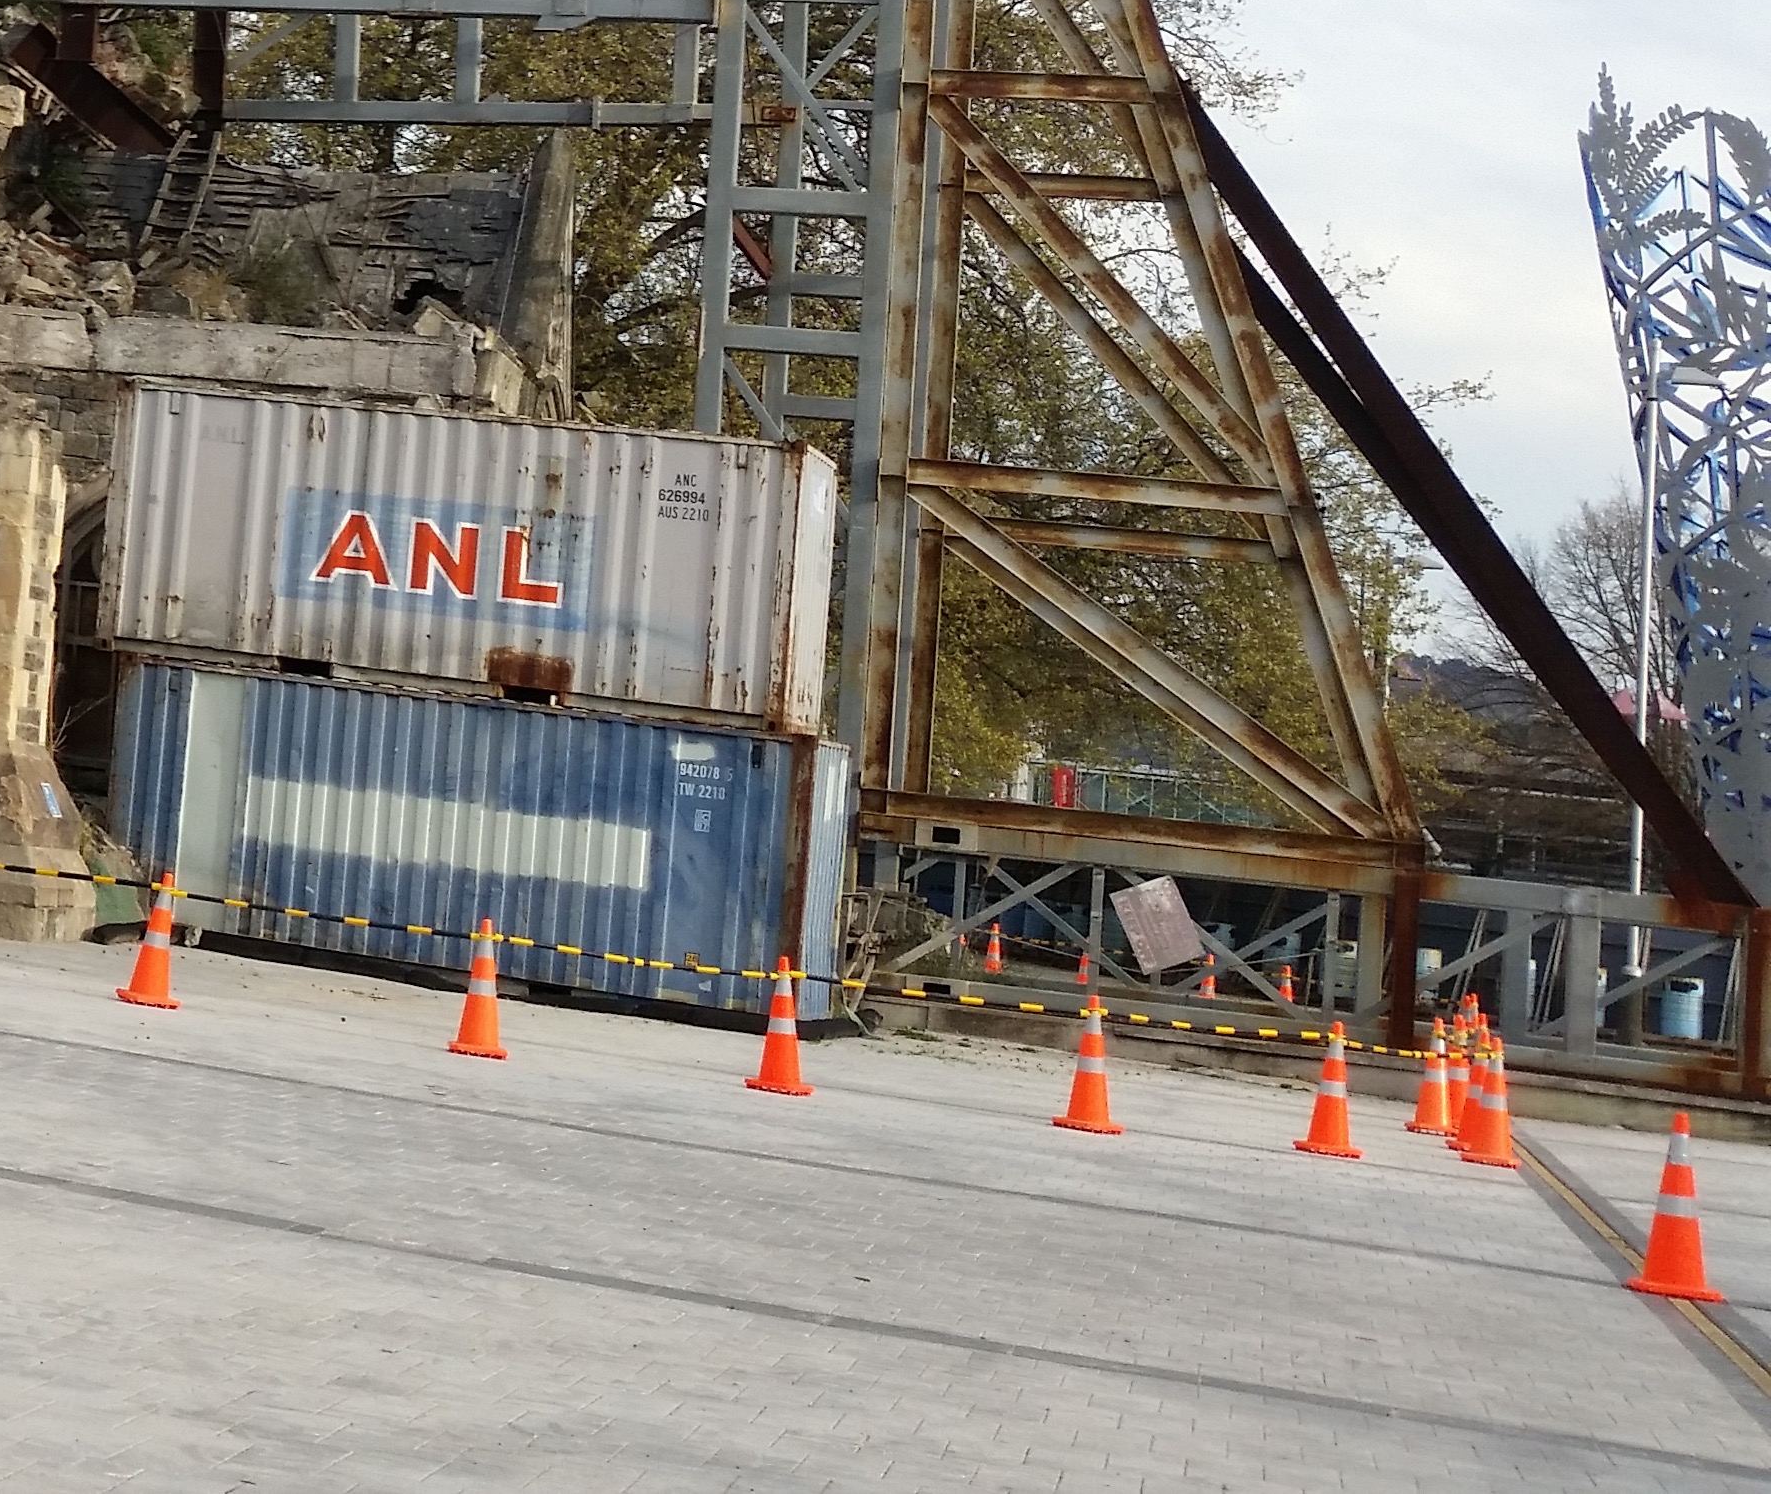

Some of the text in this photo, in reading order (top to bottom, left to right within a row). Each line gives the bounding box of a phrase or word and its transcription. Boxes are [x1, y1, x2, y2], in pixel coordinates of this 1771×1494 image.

[675, 474, 697, 487] ANC
[659, 489, 705, 504] 626994
[658, 506, 709, 521] AUS 2210
[309, 509, 564, 608] ANL
[680, 763, 720, 779] 942078
[679, 782, 726, 800] TW 2210
